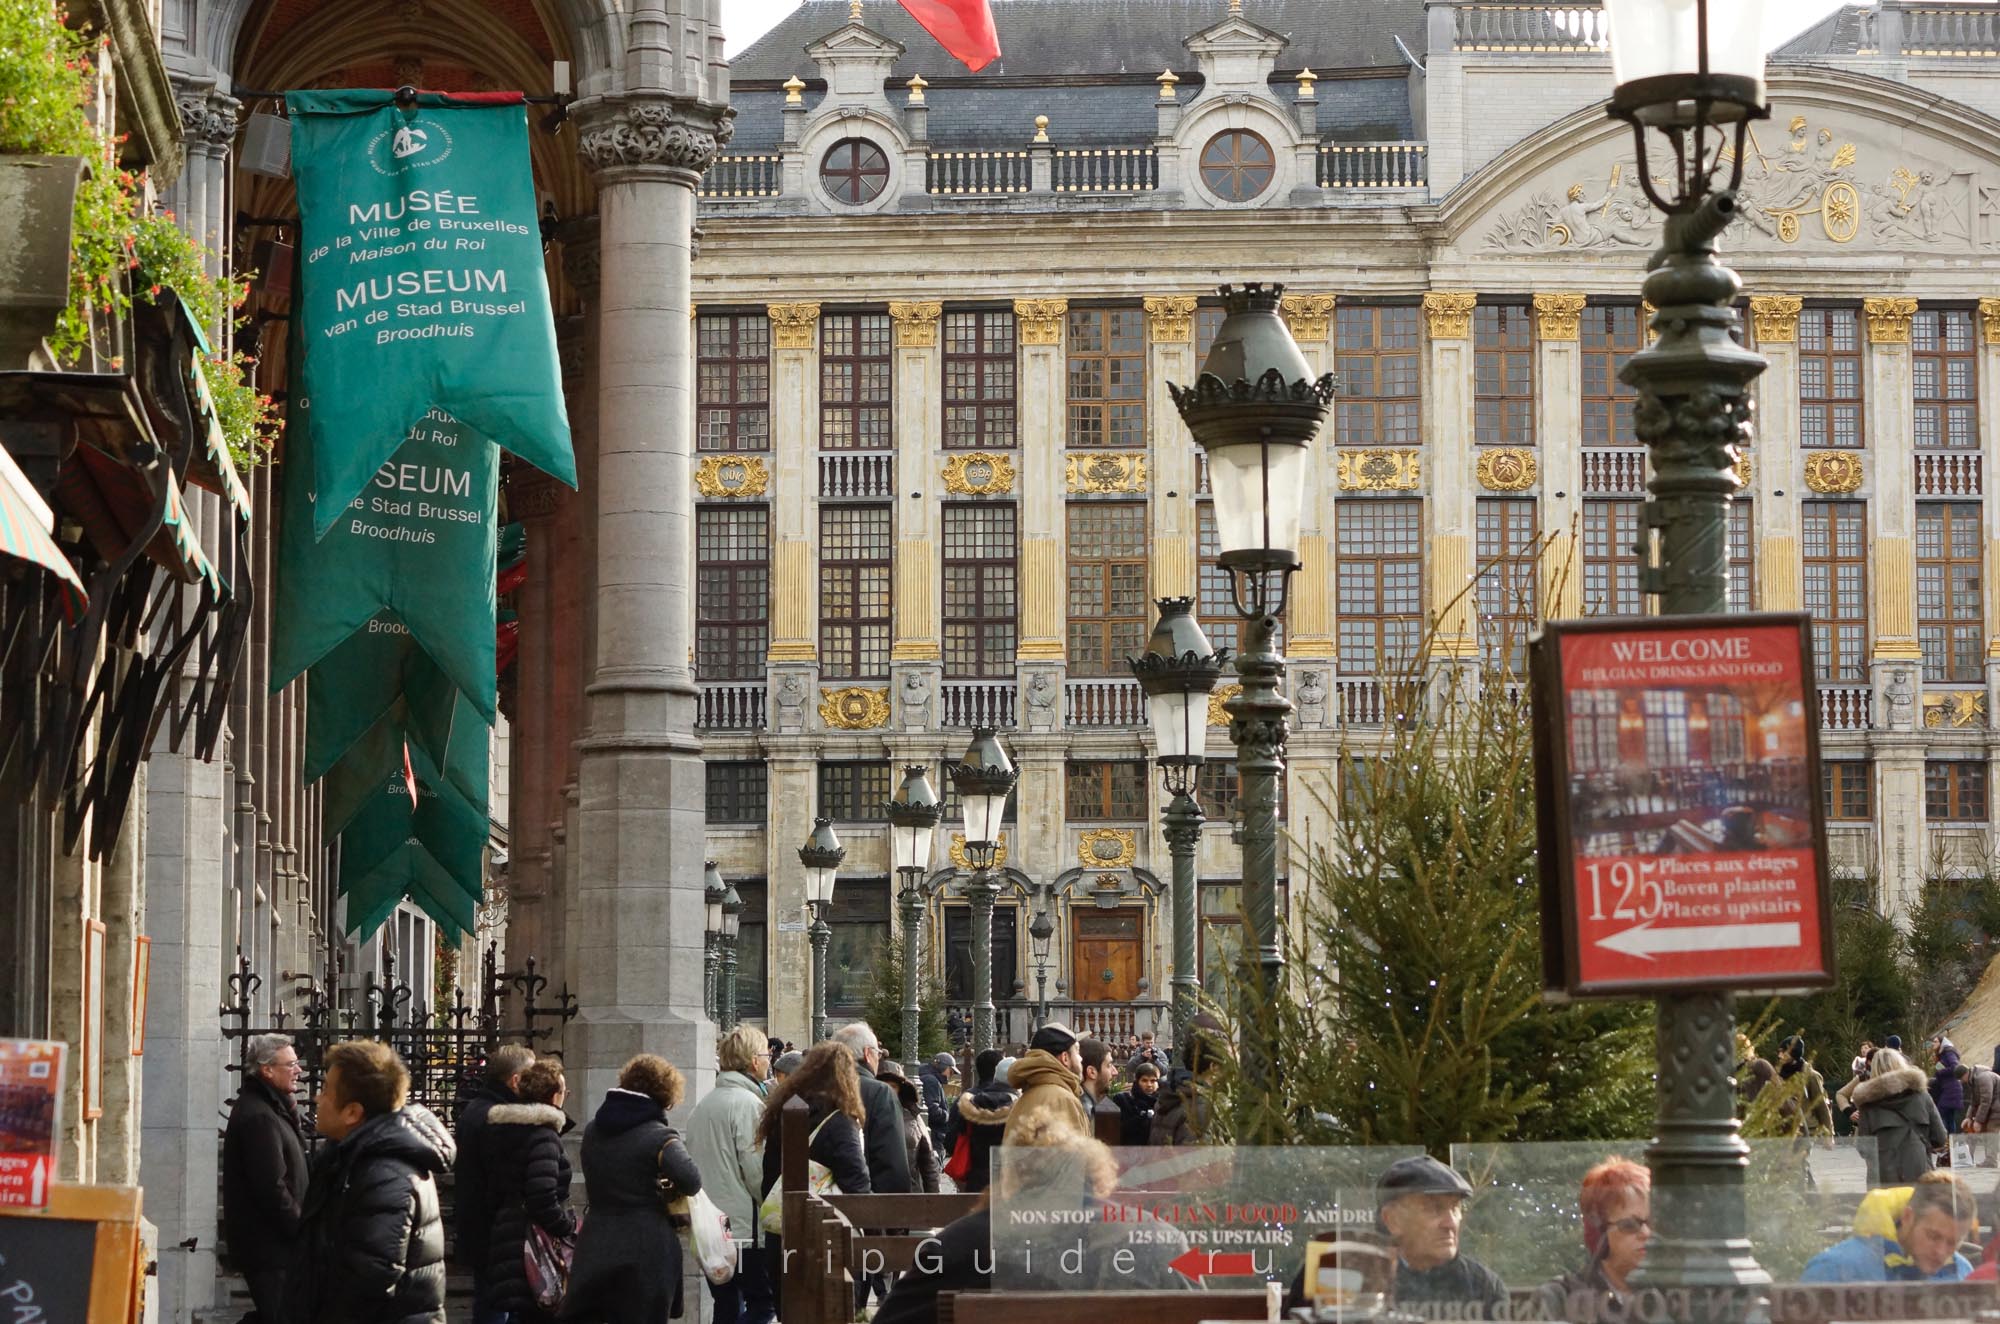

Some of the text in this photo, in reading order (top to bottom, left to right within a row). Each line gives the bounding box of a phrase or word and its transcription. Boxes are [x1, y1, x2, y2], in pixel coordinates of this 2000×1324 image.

[350, 190, 480, 225] MUSÉE
[308, 218, 529, 264] de la Ville de Bruxelles
[349, 237, 486, 265] Maison du Roi
[335, 269, 507, 312] MUSEUM
[324, 300, 525, 338] van de Stad Brussel
[376, 322, 474, 345] Broodhuis
[432, 429, 458, 446] Roi
[375, 461, 471, 497] SEUM
[371, 497, 411, 516] Stad
[418, 502, 481, 524] Brussel
[350, 519, 436, 544] Broodhuis
[1611, 637, 1750, 662] WELCOME
[1582, 661, 1783, 682] BELGIAN DRINKS AND FOOD
[1659, 855, 1798, 875] Places aux étages
[1585, 861, 1663, 920] 125
[1664, 877, 1796, 899] Boven plaatsen
[1662, 898, 1801, 920] Places upstairs
[1010, 1202, 1376, 1225] NON STOP BELGIAN FOOD AND DRI
[1128, 1230, 1293, 1244] 125 SEATS UPSTAIRS
